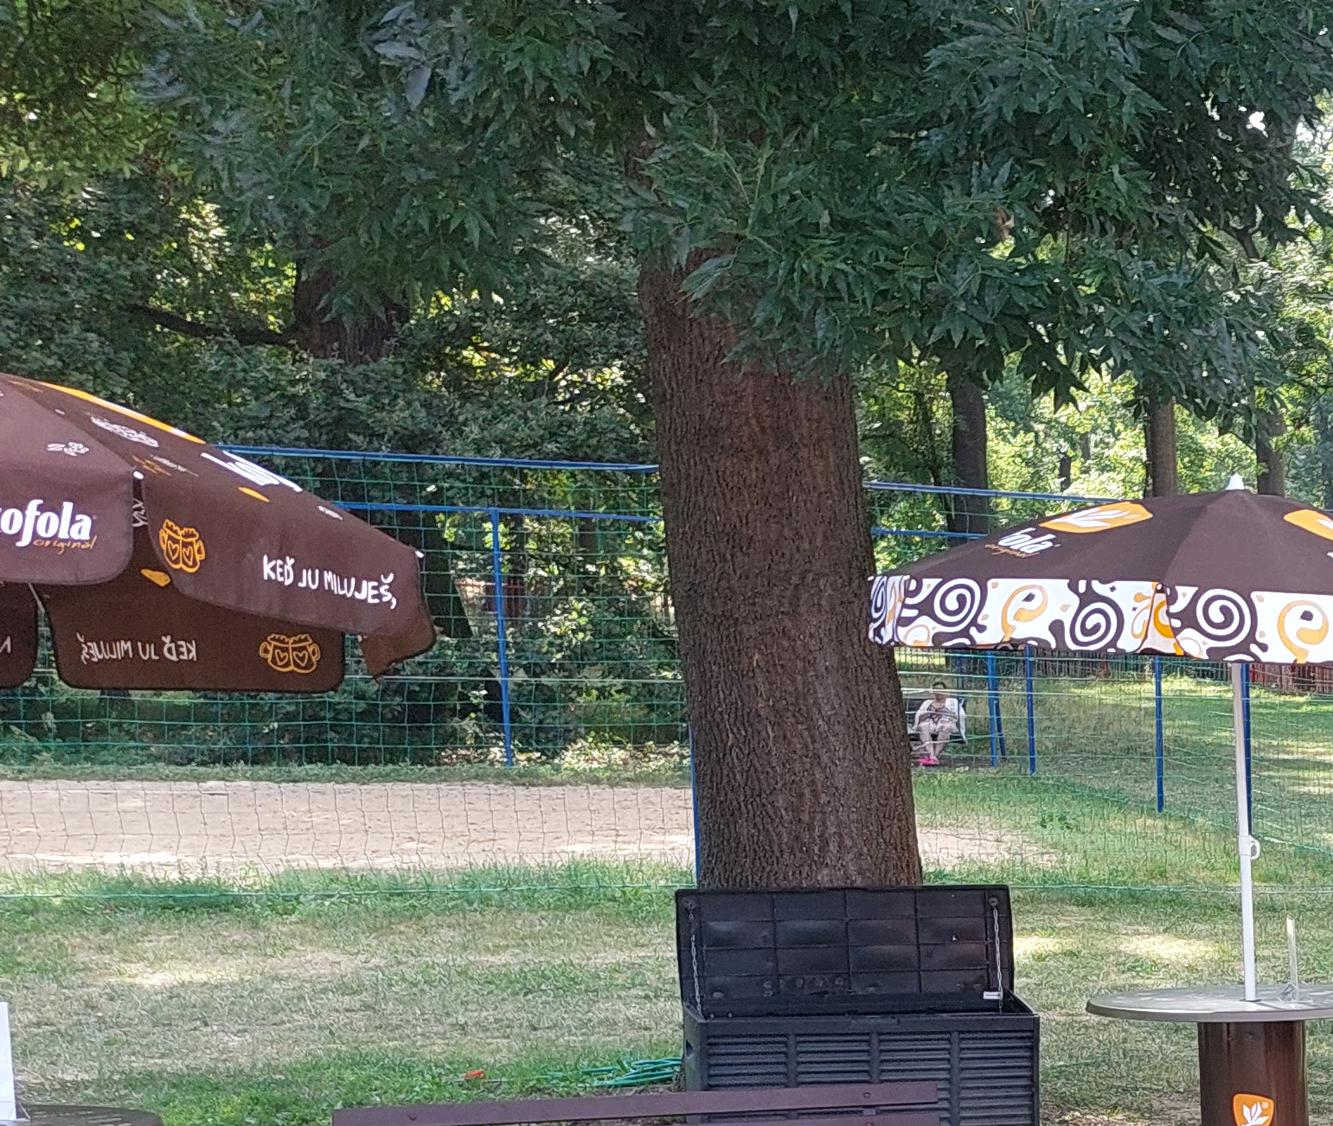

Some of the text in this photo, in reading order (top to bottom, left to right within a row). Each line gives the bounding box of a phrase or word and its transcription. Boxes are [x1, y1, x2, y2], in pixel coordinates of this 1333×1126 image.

[0, 499, 92, 547] ofola
[33, 536, 98, 555] original
[298, 569, 319, 590] JU
